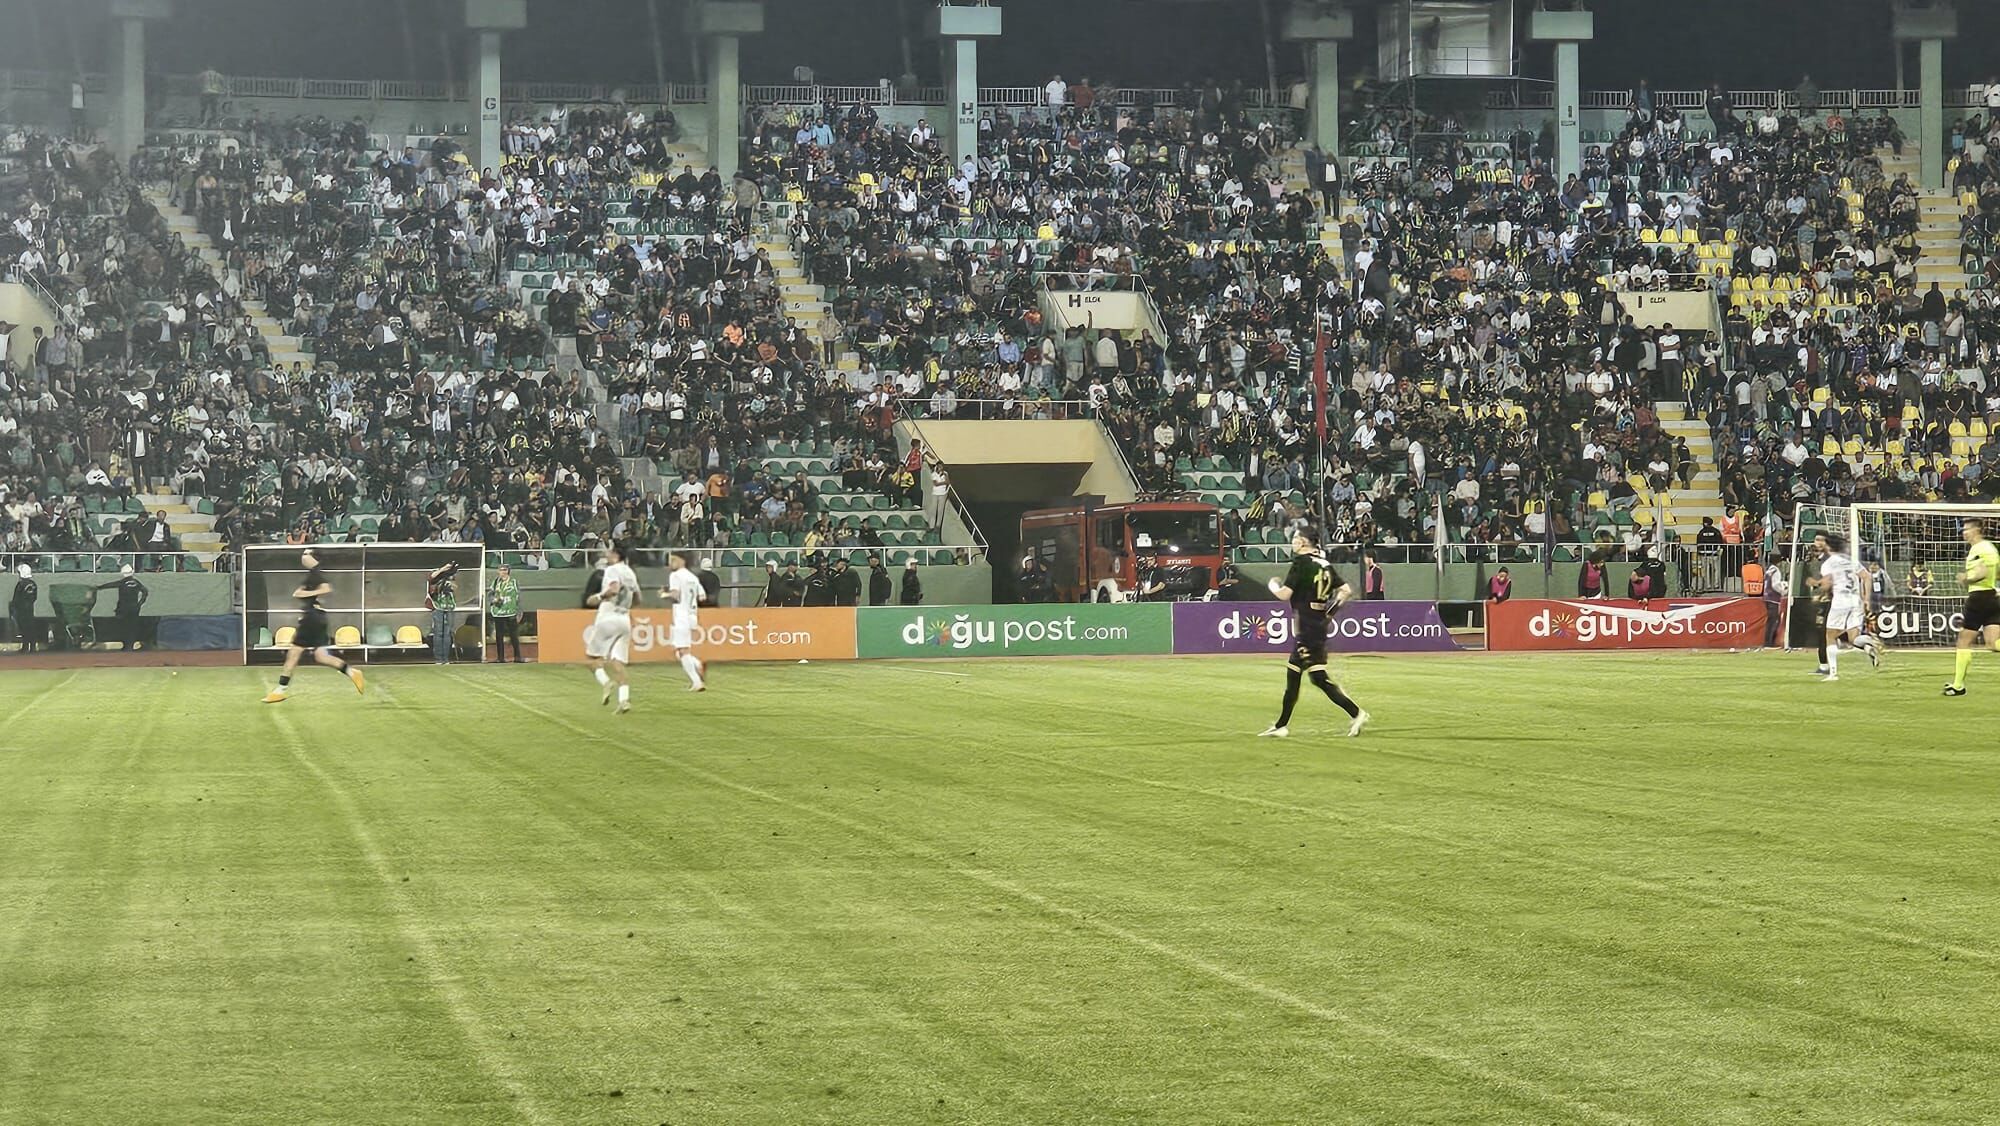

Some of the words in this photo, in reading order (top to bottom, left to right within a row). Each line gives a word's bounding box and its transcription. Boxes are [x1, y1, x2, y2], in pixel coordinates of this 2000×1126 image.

[485, 97, 497, 110] G
[961, 102, 974, 115] H
[1069, 294, 1081, 307] H
